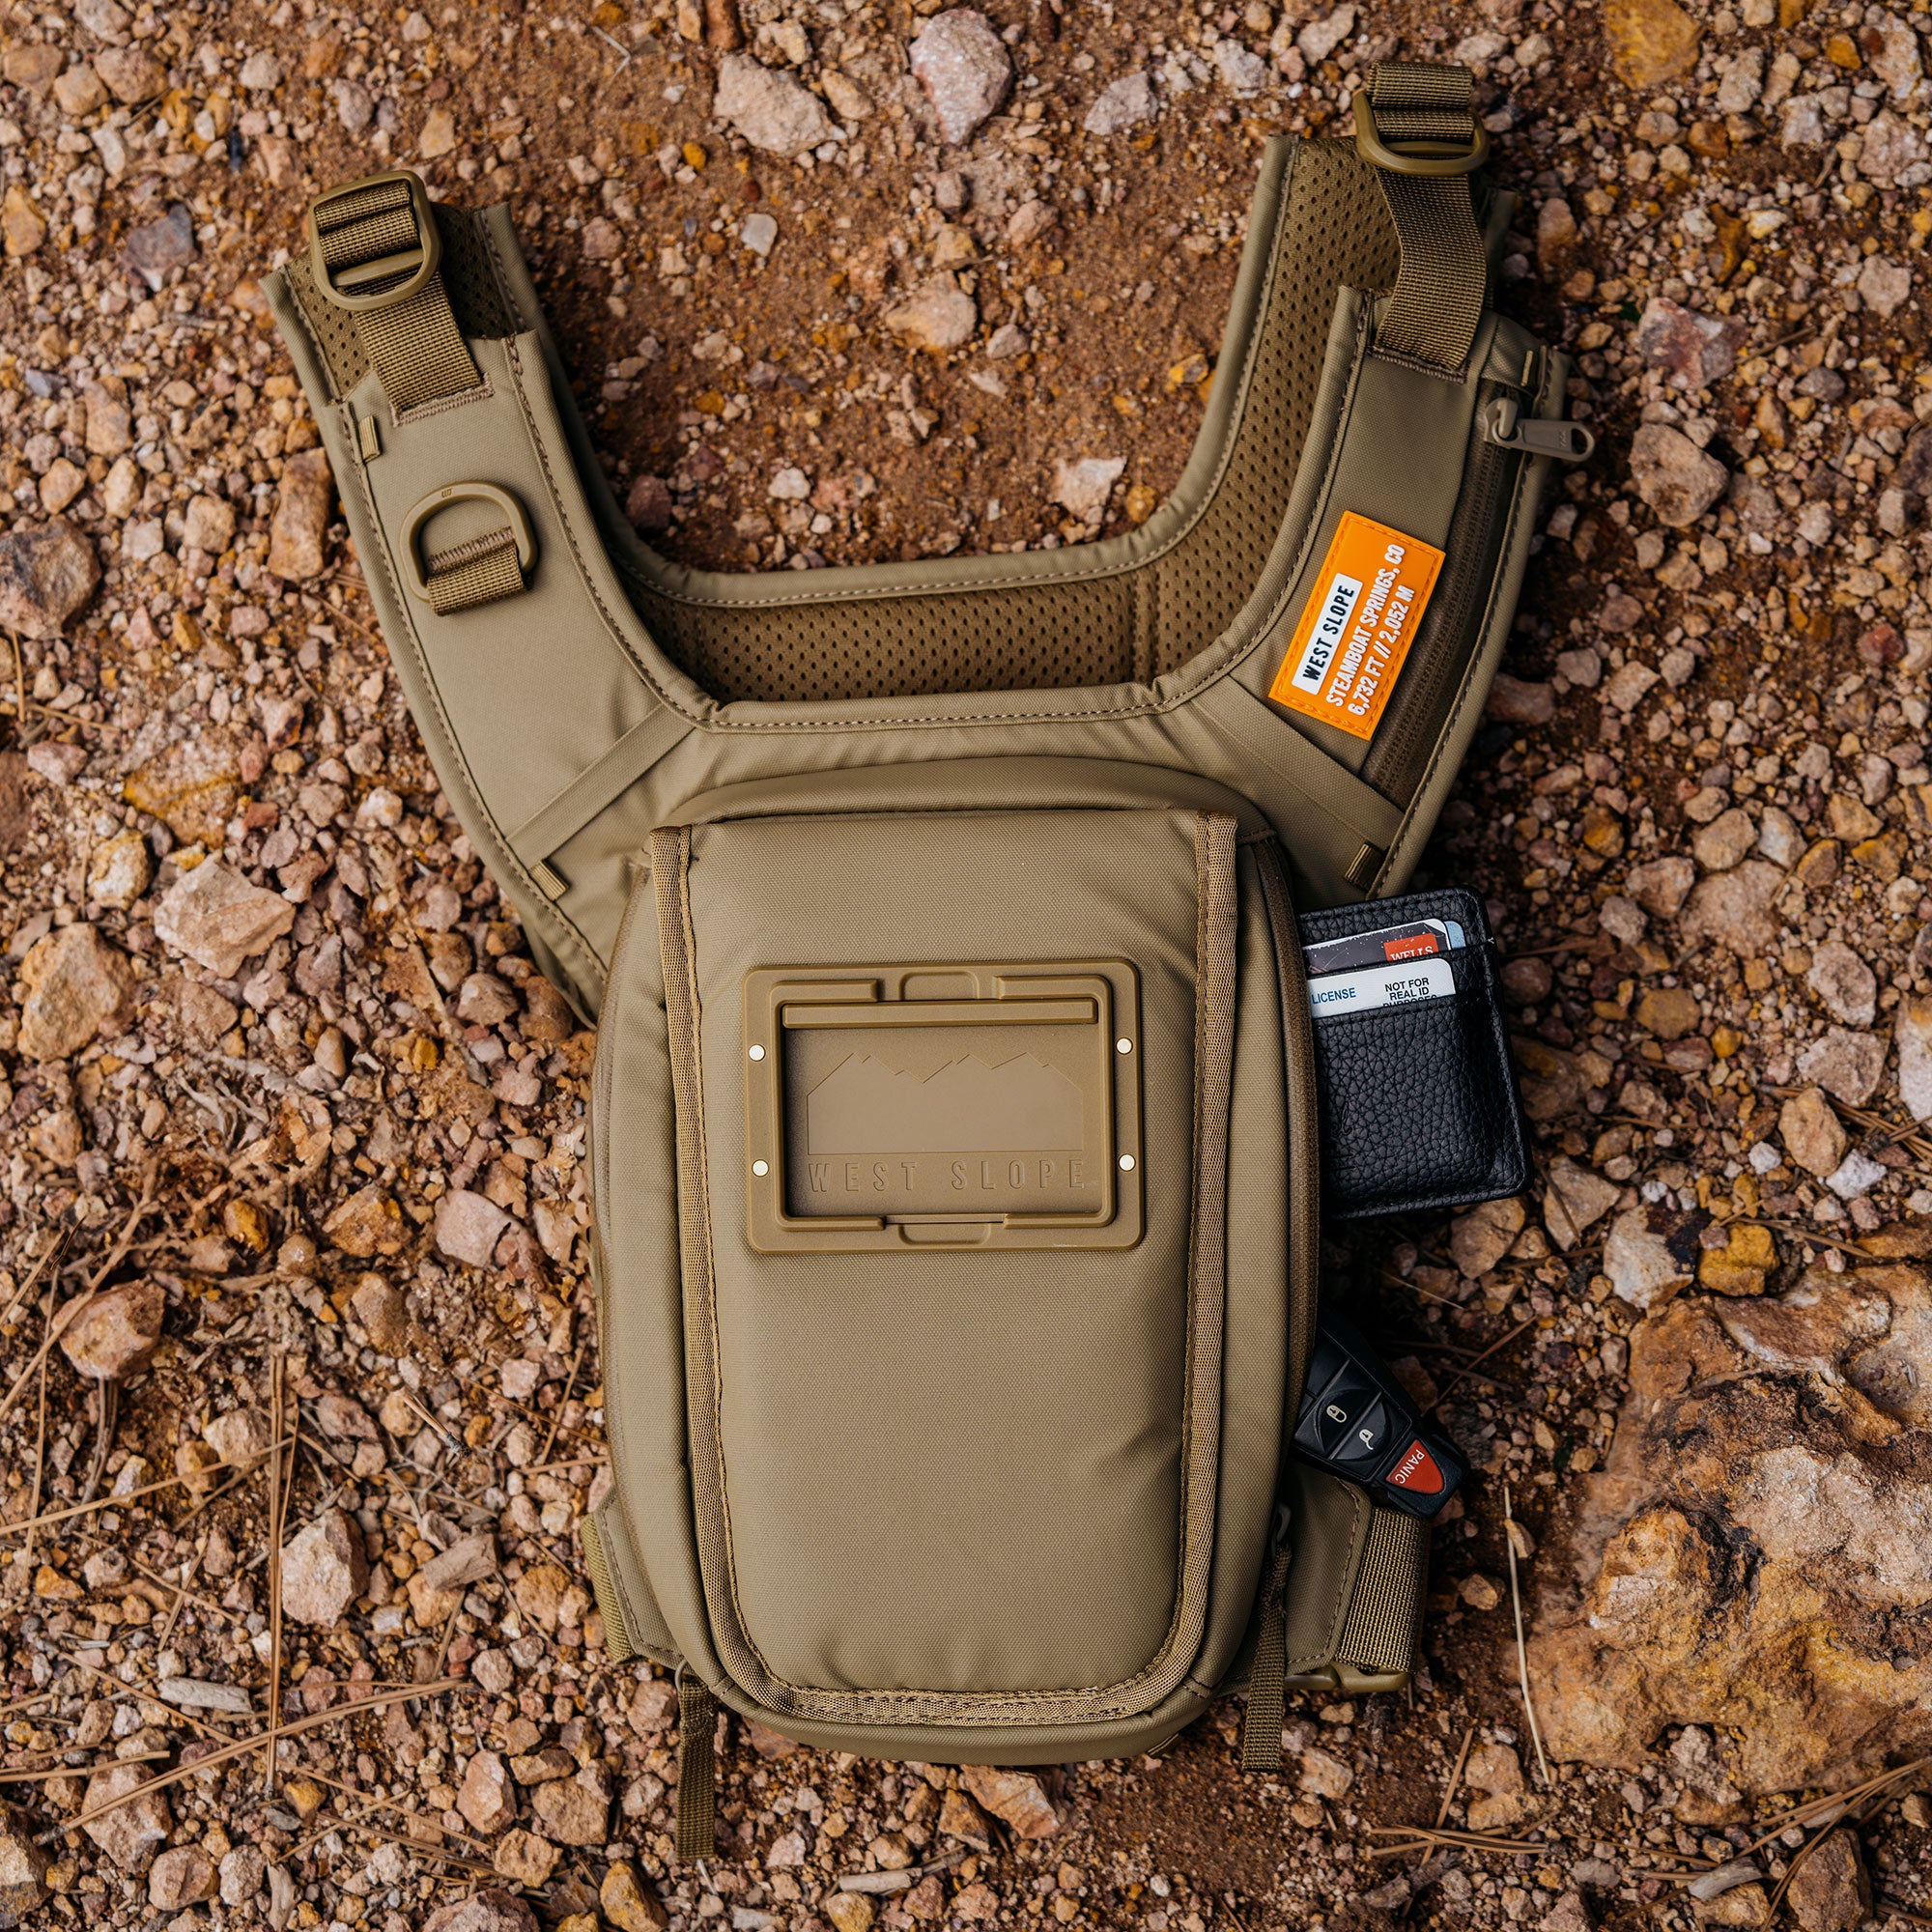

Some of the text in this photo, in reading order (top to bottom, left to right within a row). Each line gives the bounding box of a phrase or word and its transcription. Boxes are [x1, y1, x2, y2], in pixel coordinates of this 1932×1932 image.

[1302, 584, 1354, 681] WEST SLOPE
[1326, 626, 1372, 706] STEAMBOAT
[1384, 544, 1406, 565] CO
[1348, 674, 1378, 716] 6,732
[1366, 656, 1385, 677] FT
[1379, 601, 1408, 643] 2,052
[1396, 584, 1414, 603] M
[1311, 987, 1357, 1005] LICENSE
[1384, 977, 1430, 992] NOT FOR
[1389, 989, 1417, 1001] REAL
[1418, 986, 1430, 996] ID
[808, 1159, 1085, 1193] WEST SLOPE
[1395, 1449, 1425, 1484] PANIC
